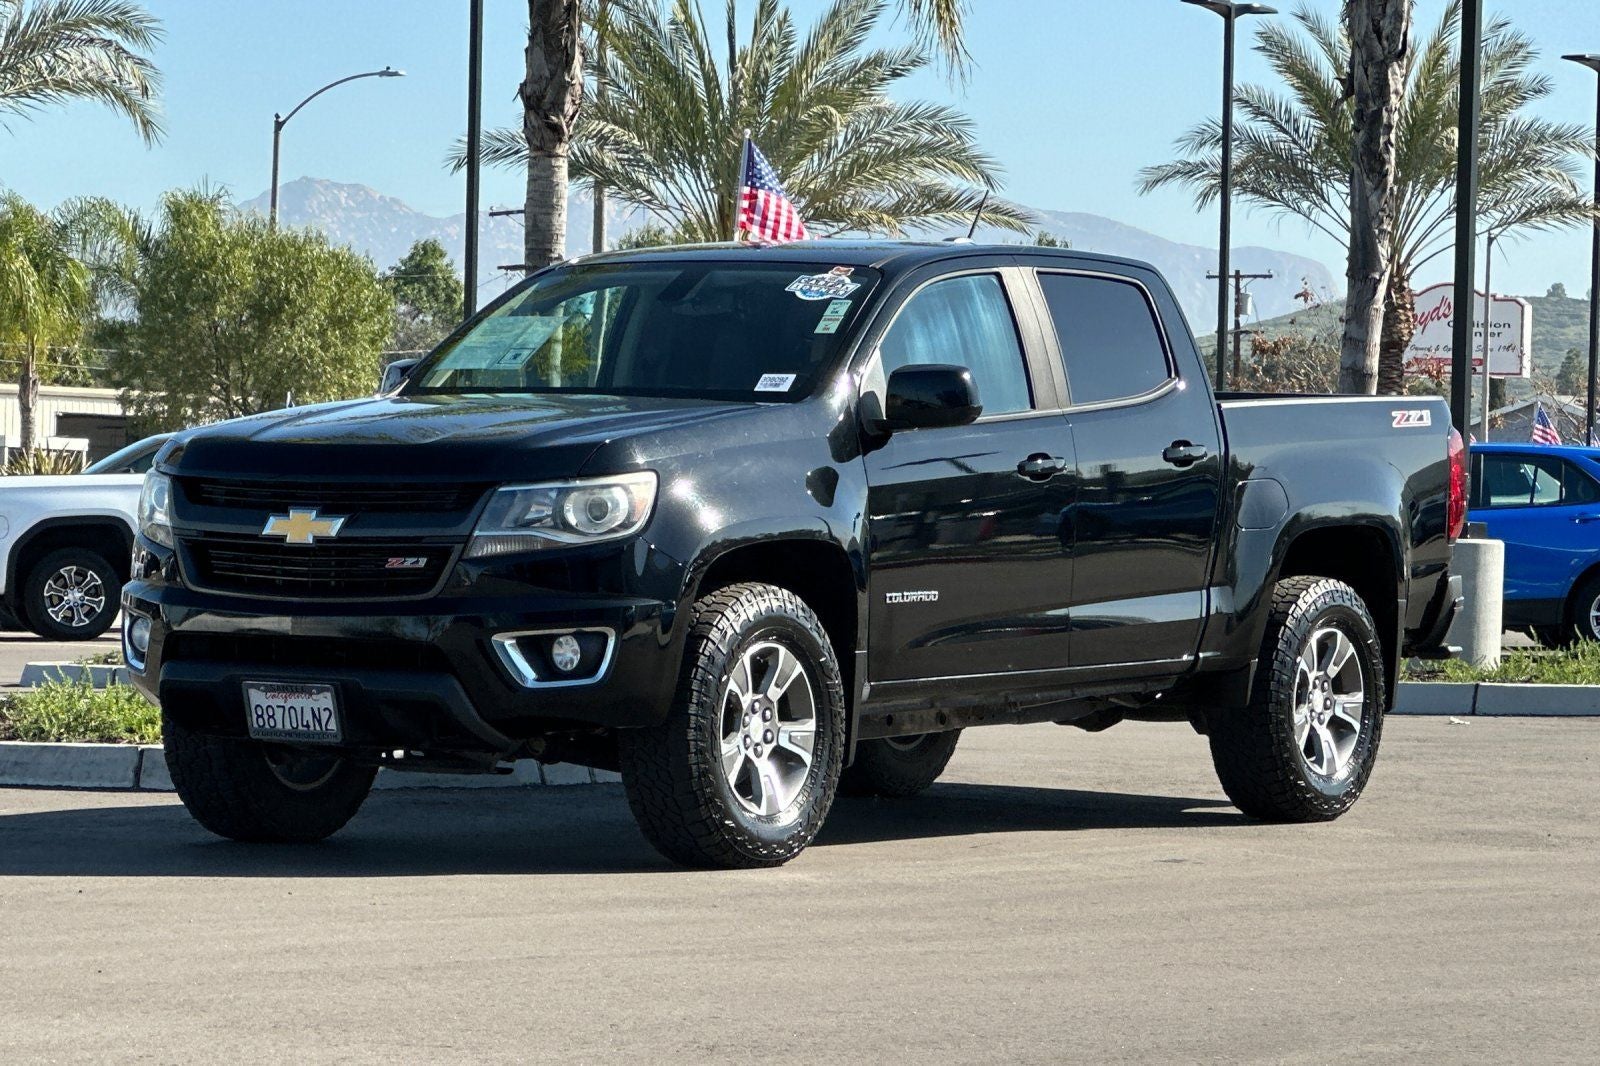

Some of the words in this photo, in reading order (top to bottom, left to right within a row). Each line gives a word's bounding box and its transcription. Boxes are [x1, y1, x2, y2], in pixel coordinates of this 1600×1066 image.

[1391, 409, 1432, 428] Z71
[385, 557, 427, 568] Z71
[885, 590, 939, 603] COLORADO
[254, 703, 336, 731] 88704N2
